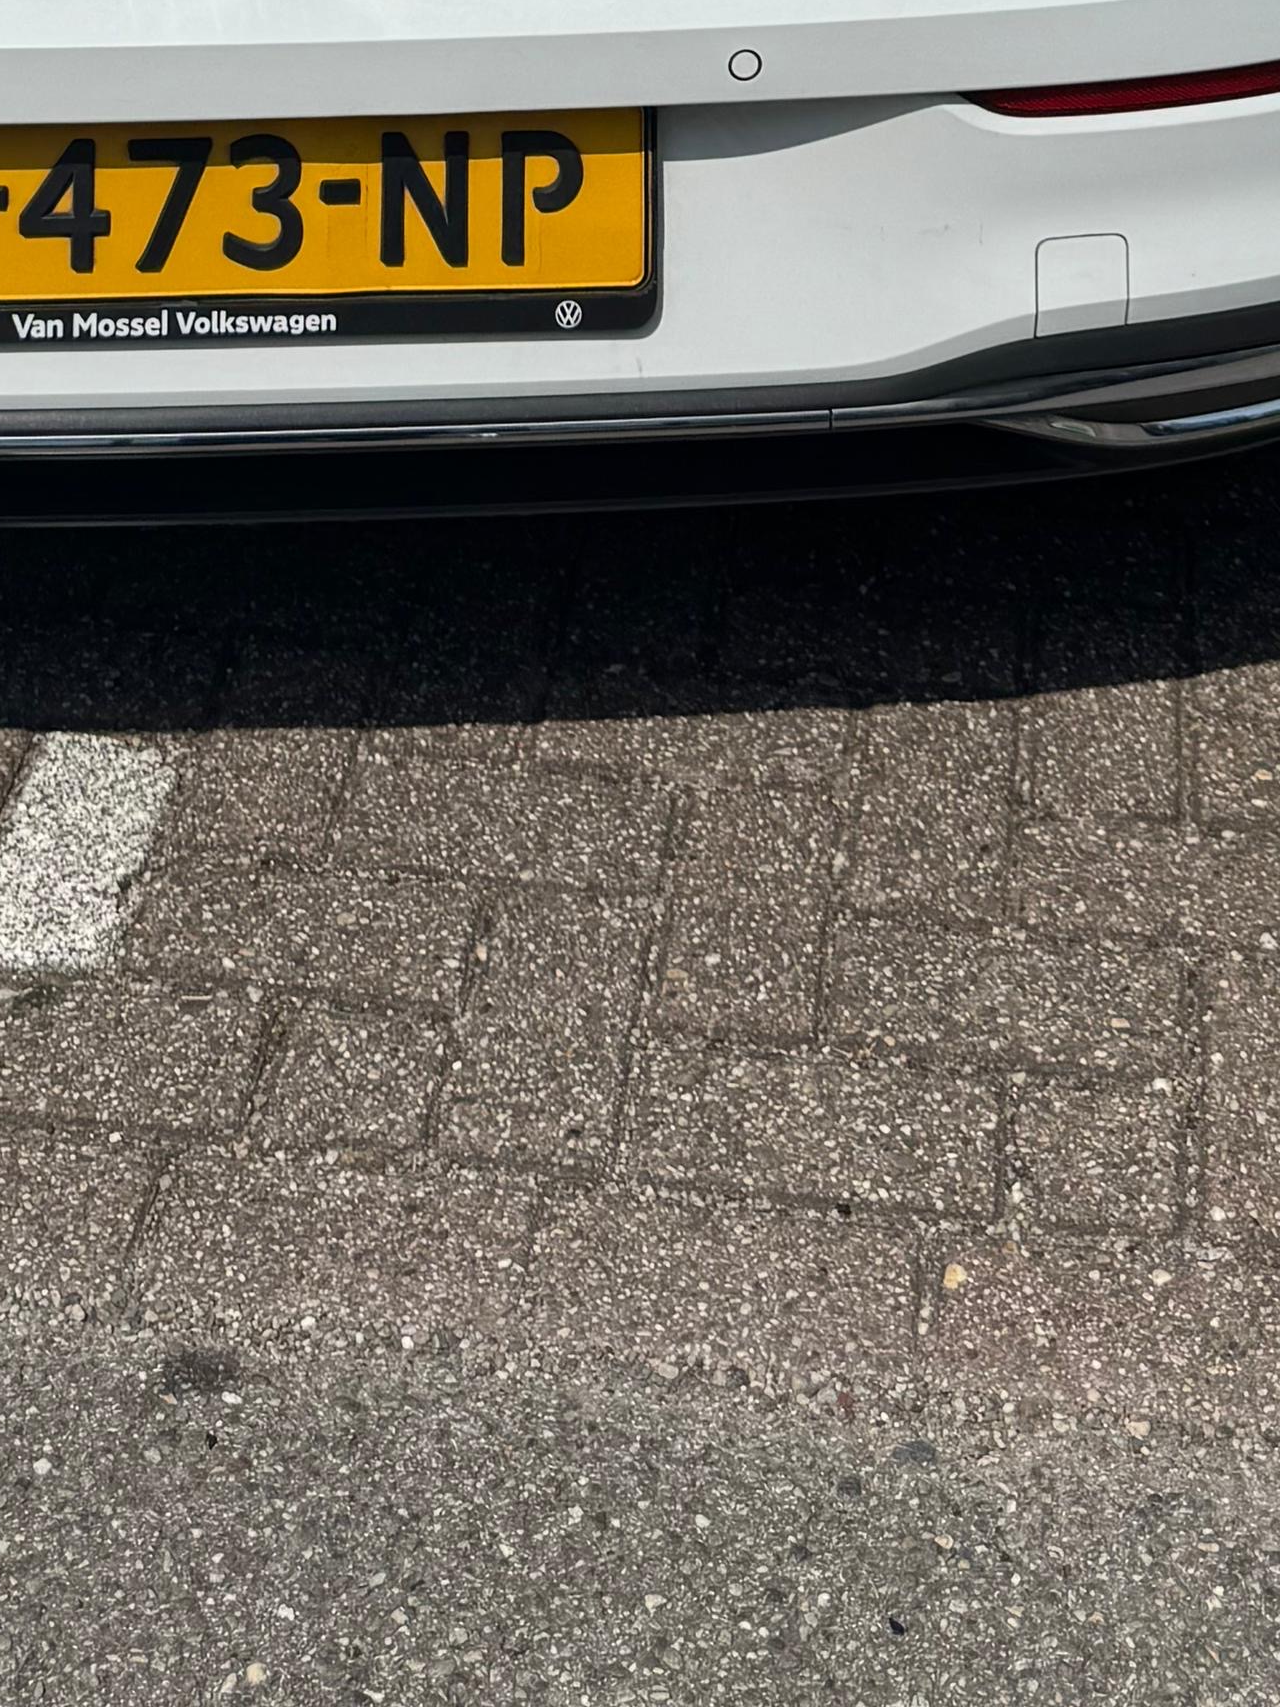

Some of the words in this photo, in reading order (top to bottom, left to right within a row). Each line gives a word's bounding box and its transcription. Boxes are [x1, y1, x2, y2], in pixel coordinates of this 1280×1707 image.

[11, 313, 64, 339] Van
[72, 309, 168, 338] Mossel
[175, 309, 337, 336] Volkswagen
